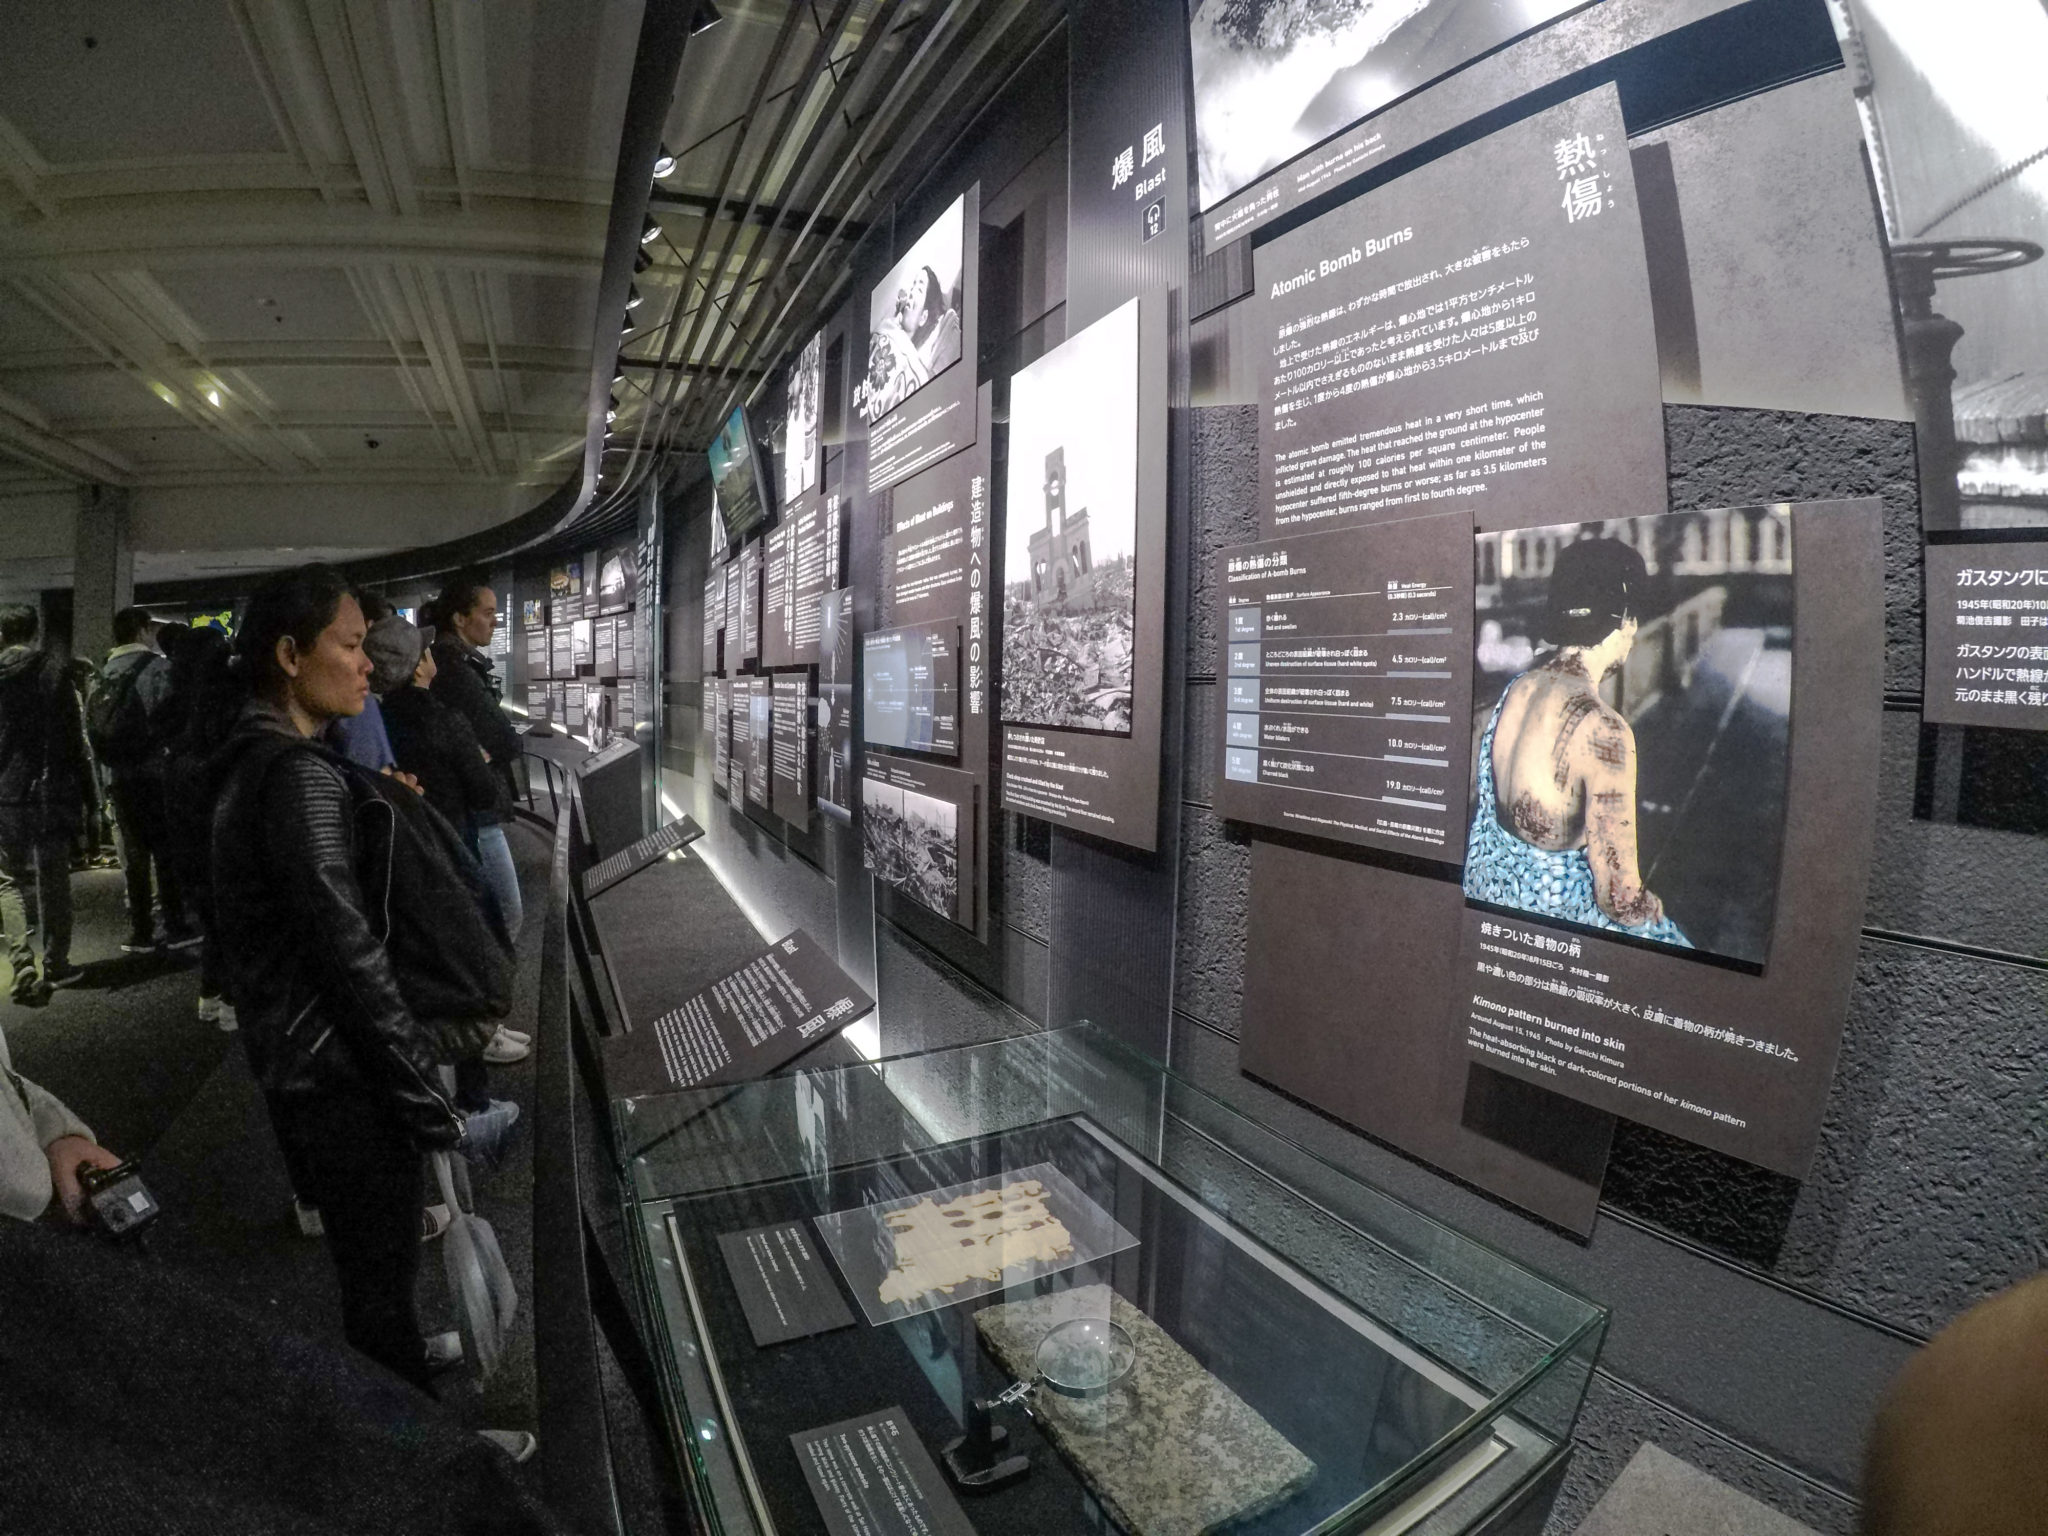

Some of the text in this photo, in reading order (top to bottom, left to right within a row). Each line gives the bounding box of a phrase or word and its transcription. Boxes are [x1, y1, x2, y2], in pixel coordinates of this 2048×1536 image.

[1112, 122, 1165, 190] 爆風
[1310, 163, 1325, 176] with
[1344, 148, 1354, 157] on
[1353, 142, 1365, 152] his
[1364, 132, 1382, 146] back
[1136, 167, 1166, 200] Blast
[1554, 132, 1602, 223] 熱傷
[1150, 223, 1158, 235] 12
[1270, 227, 1413, 300] Atomic Bomb Burns
[1274, 390, 1544, 462] The atomic bomb emitted tremendous heat in a very short time, which
[1275, 408, 1545, 475] inflicted grave damage. The heat that reached the ground at the hypocenter
[1275, 423, 1546, 488] is estimated at roughly 100 calories per square centimeter. People
[1275, 440, 1547, 500] unshielded and directly exposed to that heat within one kilometer of the
[1275, 457, 1547, 514] hypocenter suffered fifth-degree burns or worse; as far as 3.5 kilometers
[1275, 483, 1488, 526] from the hypocenter, burns ranged from first to fourth degree.
[970, 476, 982, 714] 建造物への爆風の影響
[1227, 567, 1307, 583] Classification of A-bomb Burns
[1392, 612, 1404, 622] 2.3
[1957, 600, 2048, 610] 1945年(昭和20年)10
[1392, 654, 1403, 664] 4.5
[1391, 696, 1402, 706] 7.5
[1388, 738, 1403, 748] 10.0
[1386, 780, 1401, 790] 19.0
[1480, 921, 1582, 959] 焼きついた着物の柄
[1470, 1012, 1625, 1069] Around August 15, 1945 Photo by Genichi Kimura
[1472, 994, 1626, 1052] Kimono pattern burned into skin
[1467, 1038, 1557, 1076] were burned into her skin.
[1468, 1026, 1746, 1129] The heat-absorbing black or dark-colored portions of her kimono pattern
